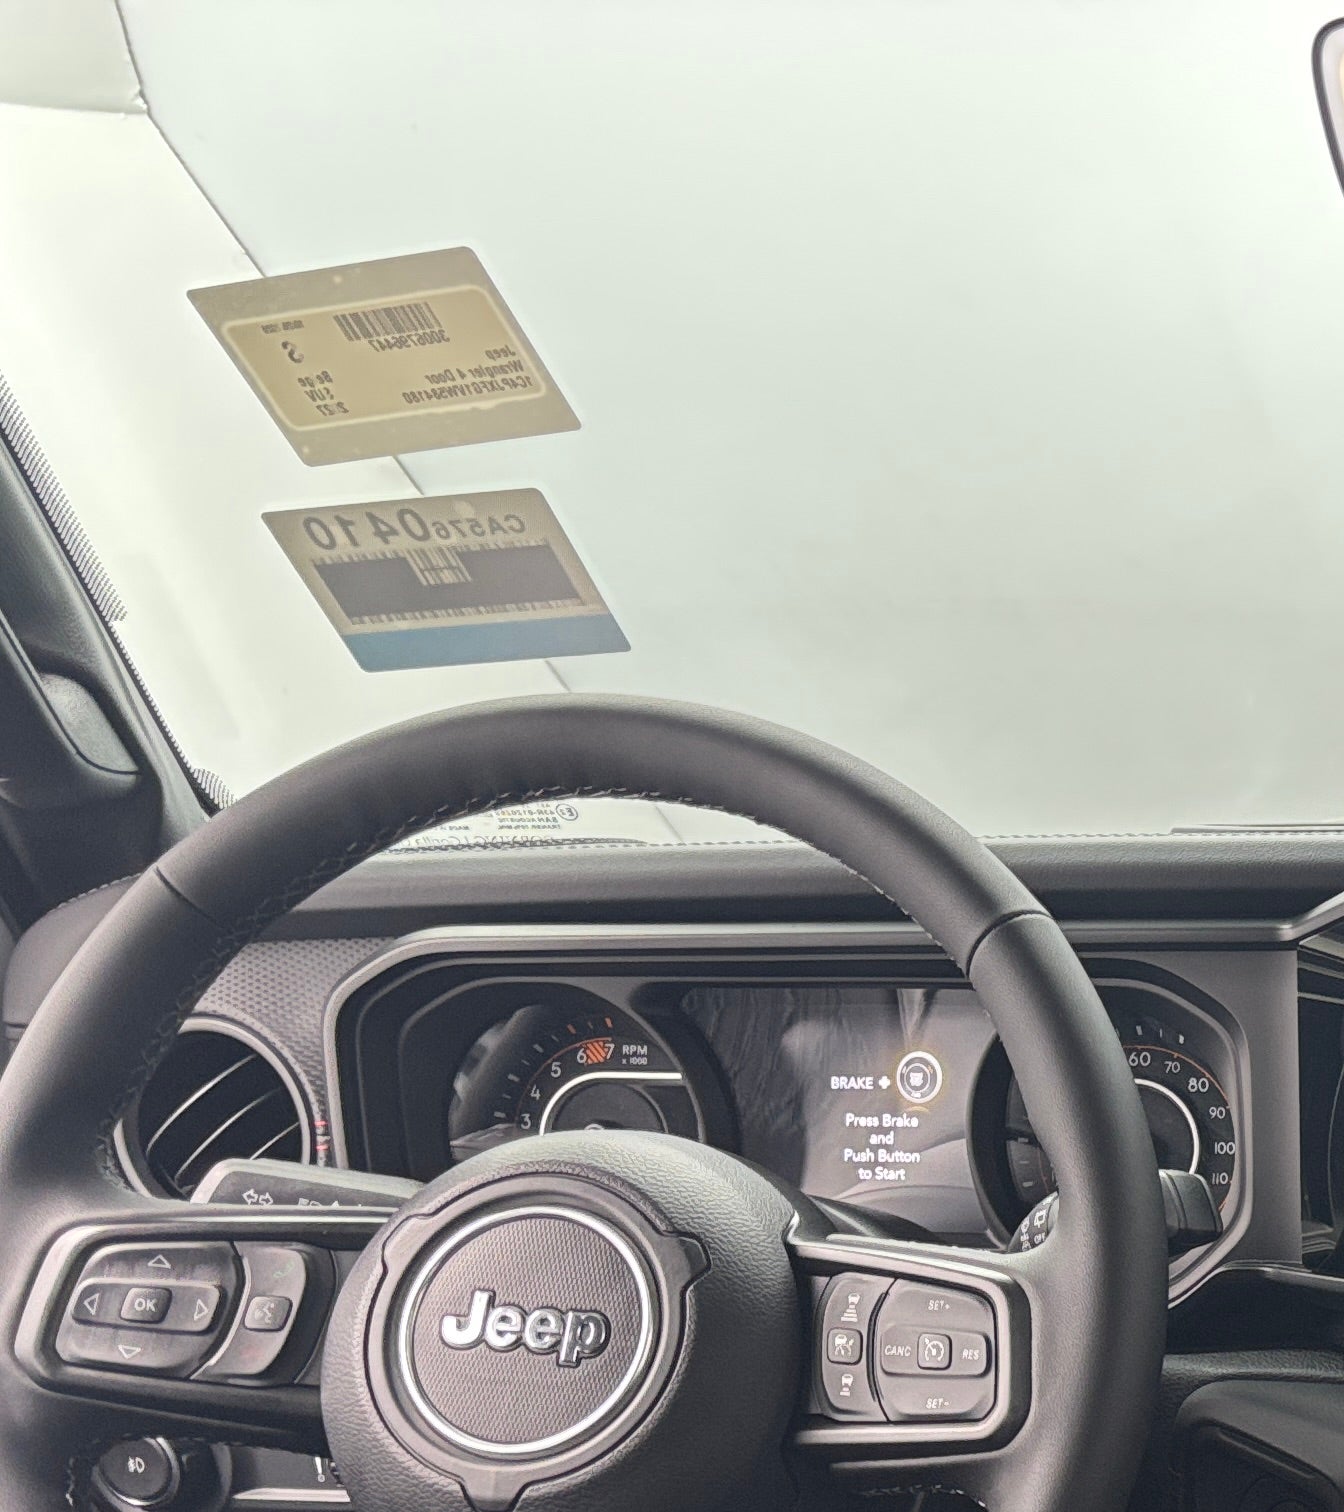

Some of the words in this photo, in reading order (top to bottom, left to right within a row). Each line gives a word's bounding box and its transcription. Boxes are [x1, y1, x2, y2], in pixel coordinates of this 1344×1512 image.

[577, 1048, 587, 1063] 6
[604, 1044, 615, 1060] 7
[622, 1045, 648, 1055] RPM
[1128, 1052, 1151, 1066] 60
[551, 1062, 561, 1078] 5
[1164, 1061, 1181, 1073] 70
[831, 1076, 874, 1090] BRAKE
[1187, 1078, 1210, 1092] 80
[530, 1086, 541, 1100] 4
[1208, 1106, 1226, 1119] 90
[520, 1113, 532, 1130] 3
[845, 1113, 879, 1127] Press
[882, 1113, 919, 1128] Brake
[869, 1131, 894, 1145] and
[1214, 1141, 1236, 1155] 100
[844, 1149, 874, 1163] Push
[877, 1149, 921, 1164] Button
[858, 1168, 872, 1180] to
[874, 1167, 906, 1180] Start
[1212, 1172, 1229, 1185] 110
[134, 1300, 156, 1312] OK
[441, 1289, 608, 1367] Jeep
[885, 1345, 912, 1357] CANC
[962, 1350, 980, 1360] RES
